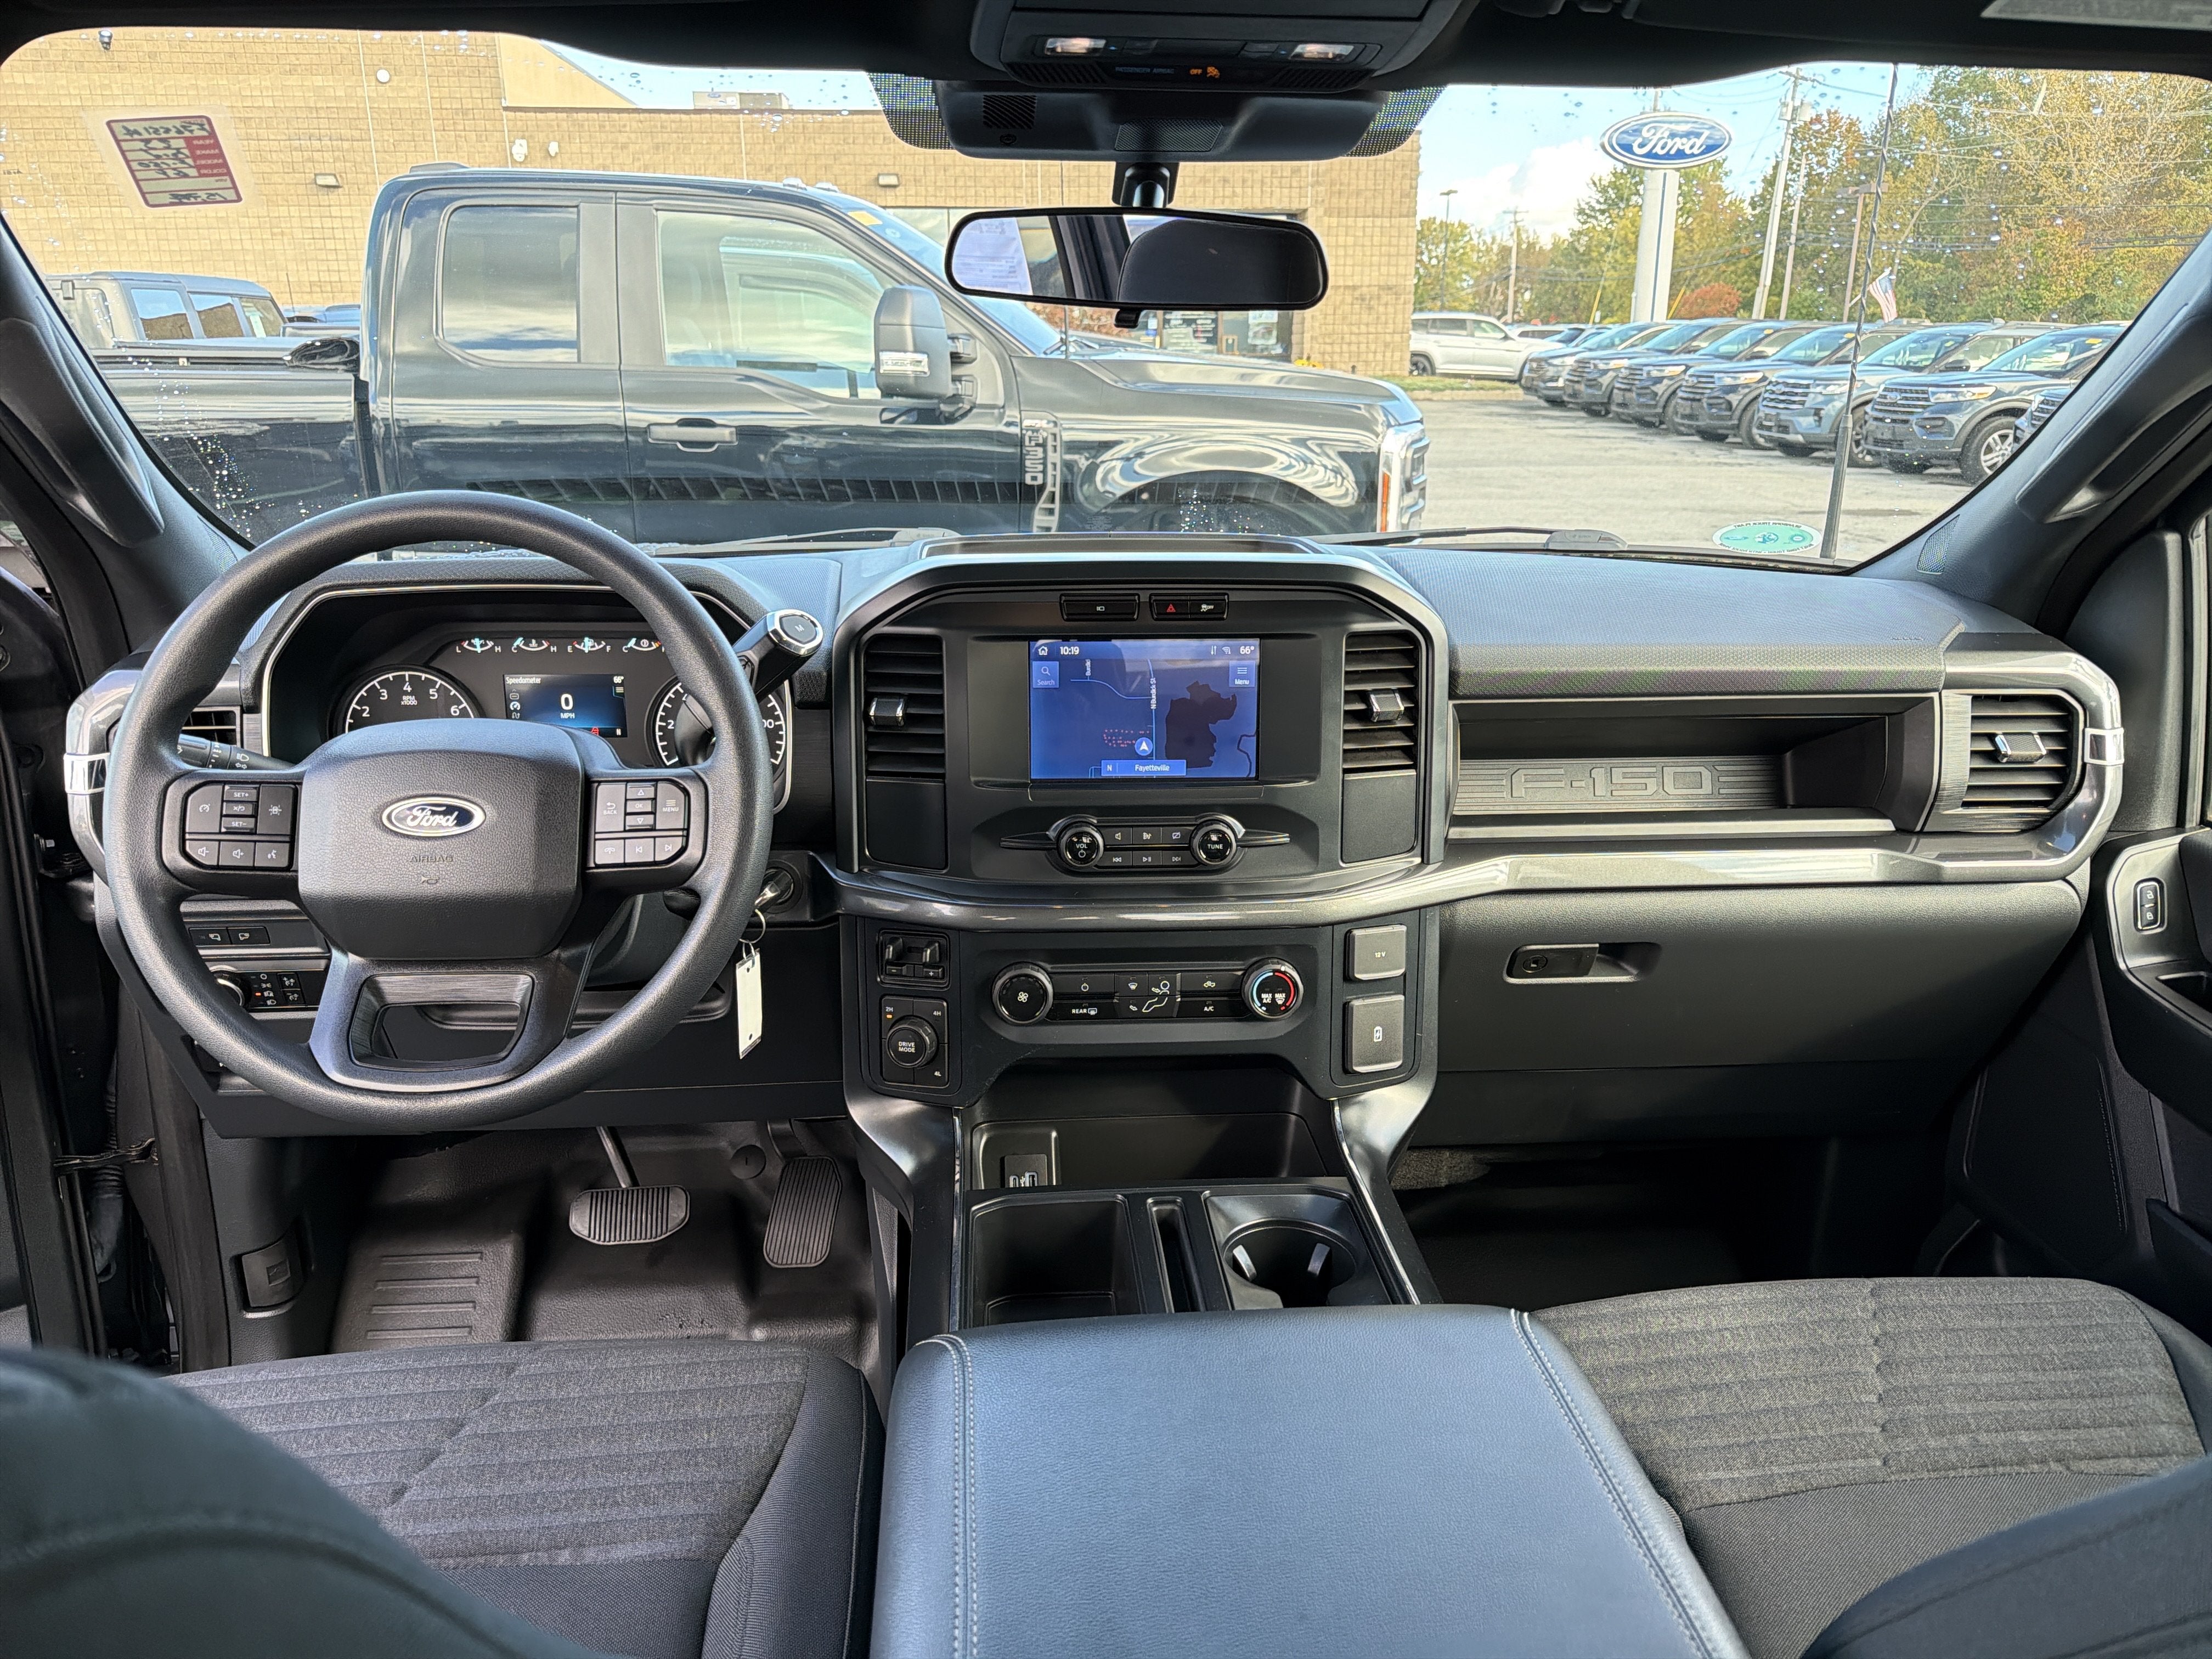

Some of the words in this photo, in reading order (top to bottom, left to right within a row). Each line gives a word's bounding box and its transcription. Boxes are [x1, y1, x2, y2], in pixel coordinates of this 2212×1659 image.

[1632, 123, 1710, 155] Ford
[1059, 646, 1079, 656] 10:19
[1240, 646, 1255, 654] 66°
[505, 676, 542, 685] Speedometer
[403, 682, 412, 692] 4
[380, 689, 388, 700] 3
[429, 689, 438, 699] 5
[561, 693, 573, 710] 0
[362, 706, 370, 717] 2
[450, 705, 460, 716] 6
[1135, 764, 1170, 773] Fayetteville
[1511, 765, 1713, 798] F-150
[407, 805, 459, 827] Ford
[410, 854, 454, 863] AIRBAG
